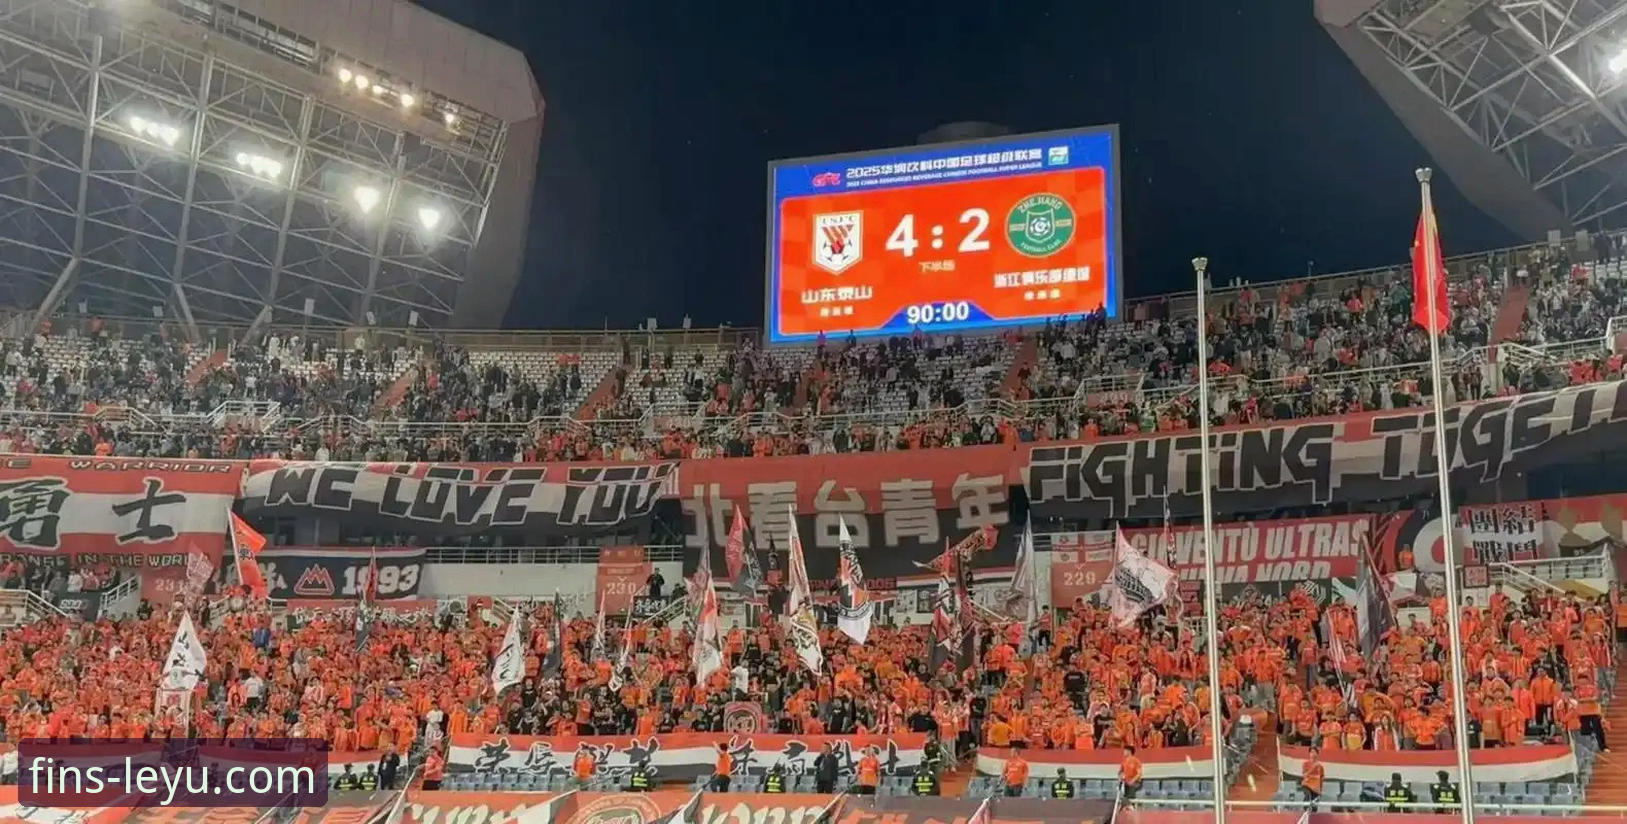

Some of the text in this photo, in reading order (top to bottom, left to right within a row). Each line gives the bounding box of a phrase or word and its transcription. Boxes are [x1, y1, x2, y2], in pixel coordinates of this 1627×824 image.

[801, 285, 873, 304] 山东泰山
[907, 301, 969, 323] 90:00
[70, 460, 231, 473] WARRIOR
[264, 462, 680, 526] WE LOVE YOU
[0, 476, 188, 550] 勇士
[681, 473, 1009, 549] 北看台青年
[1264, 518, 1371, 561] ULTRAS
[77, 553, 98, 566] IN
[342, 564, 421, 596] 1993
[606, 582, 637, 595] 230
